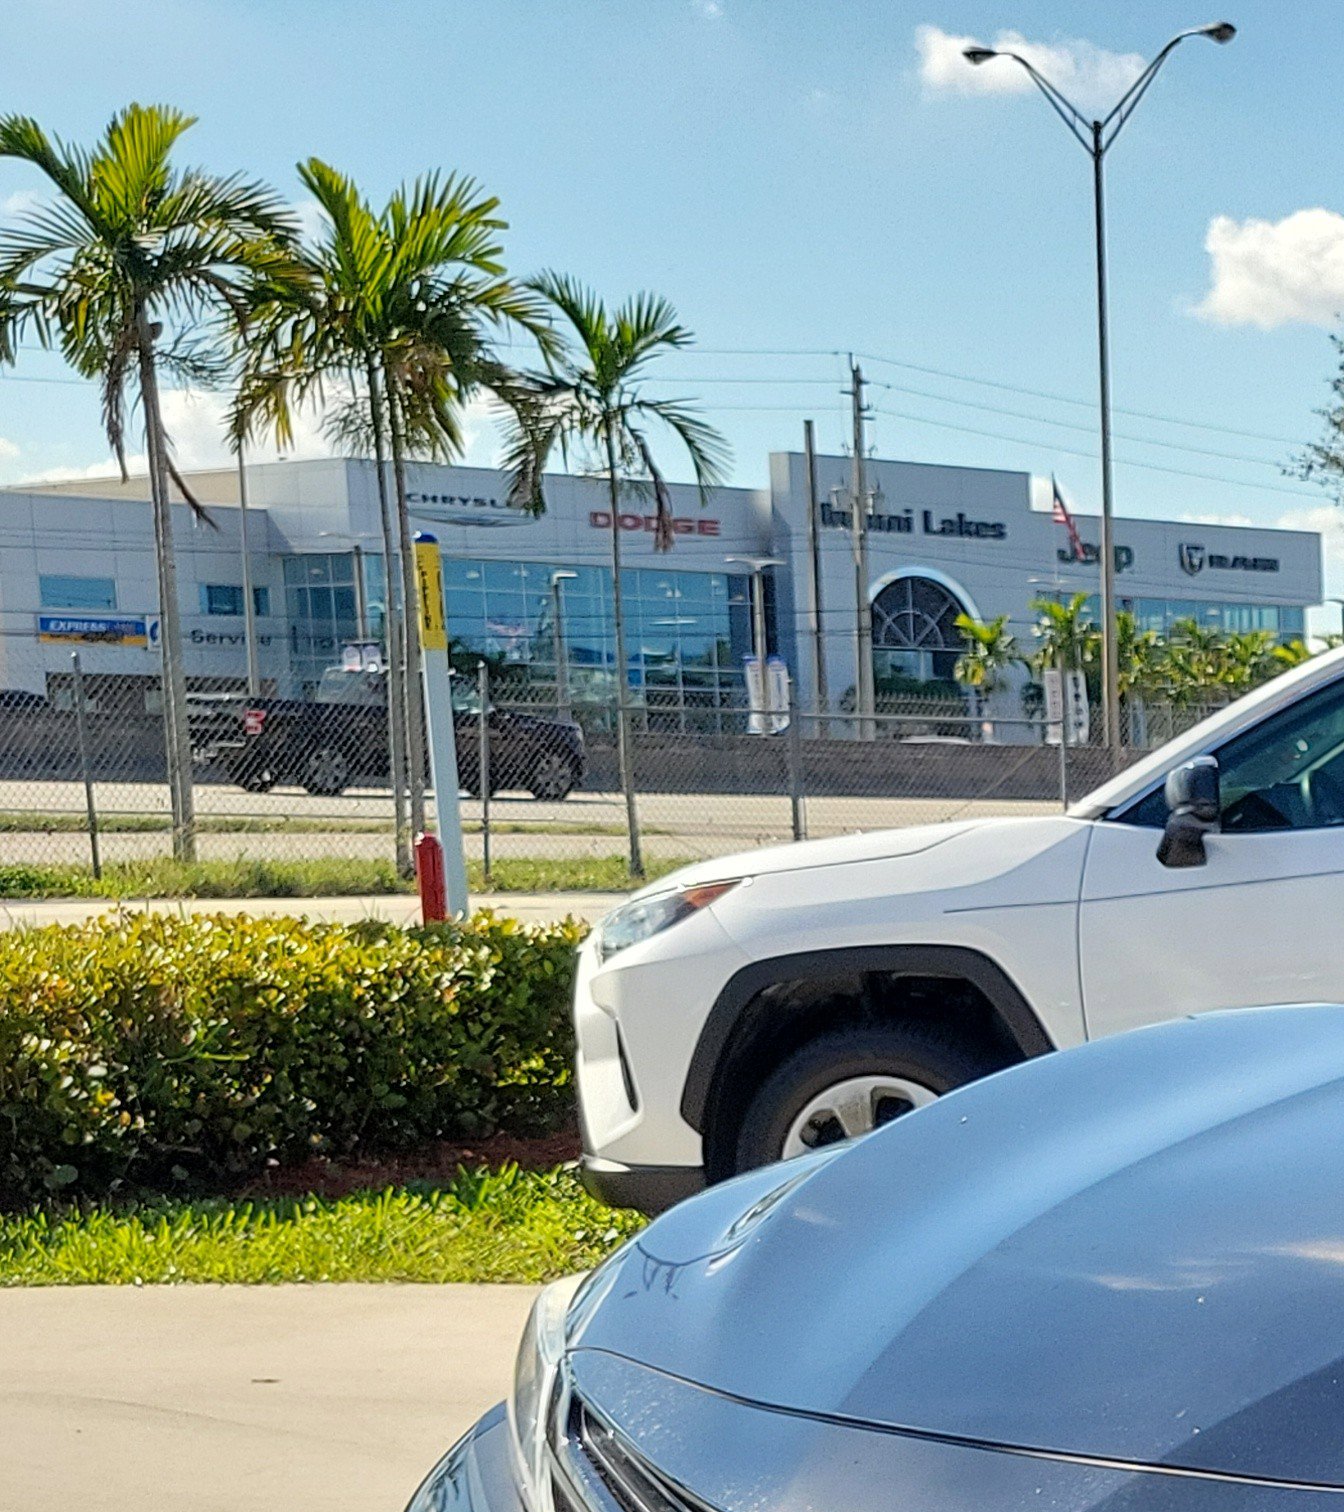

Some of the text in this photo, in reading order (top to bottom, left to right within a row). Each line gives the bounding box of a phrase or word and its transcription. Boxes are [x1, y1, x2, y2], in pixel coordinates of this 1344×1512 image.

[404, 492, 507, 509] CHRYSL
[590, 511, 721, 537] DODGE
[923, 509, 1007, 540] Lakes
[1056, 536, 1135, 574] Jep
[189, 628, 272, 647] Servie
